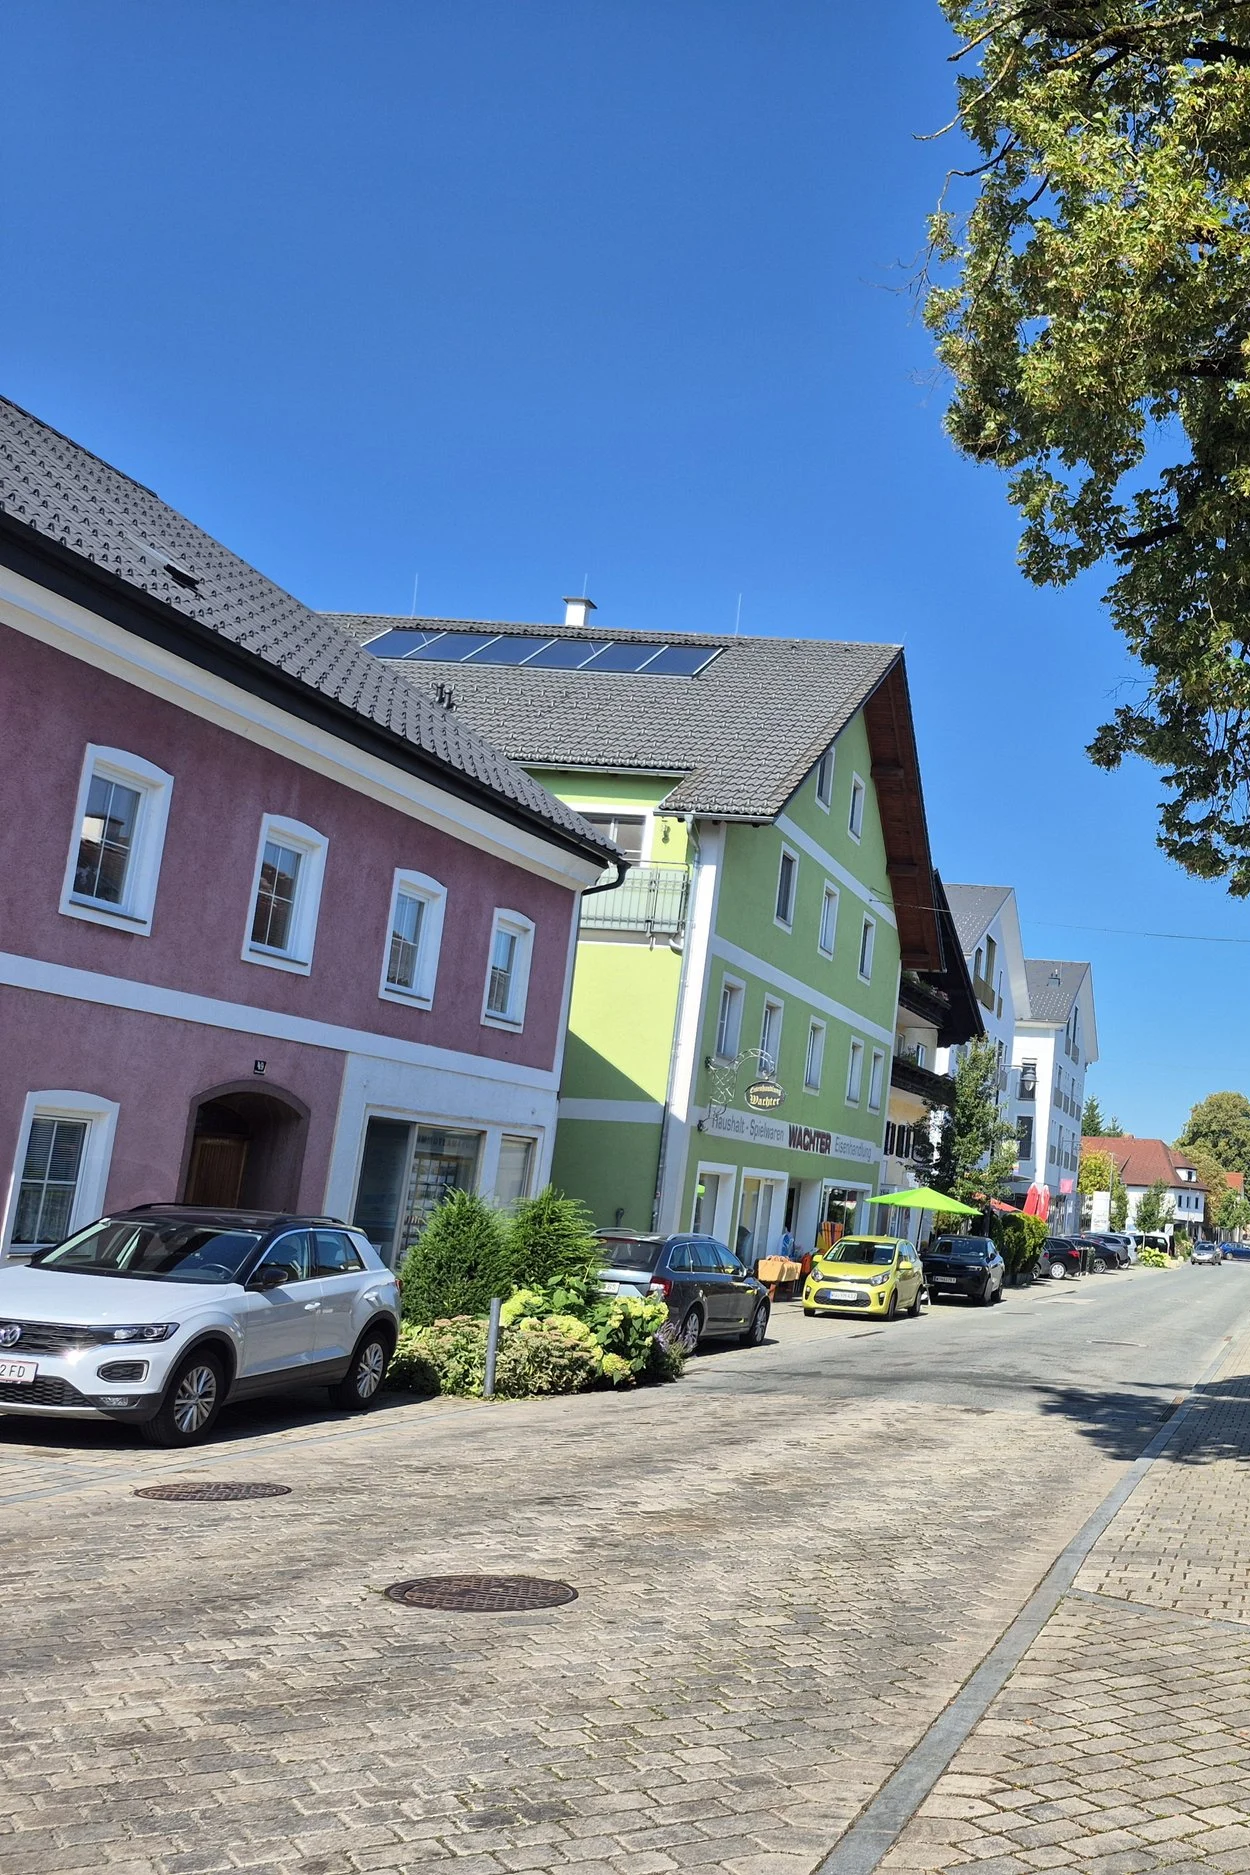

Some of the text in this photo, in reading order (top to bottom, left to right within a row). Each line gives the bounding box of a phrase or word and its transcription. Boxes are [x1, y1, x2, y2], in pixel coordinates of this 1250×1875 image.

[750, 1094, 781, 1107] Wachter
[712, 1112, 745, 1133] Haushalt
[749, 1119, 785, 1141] Spielwaren
[788, 1123, 832, 1155] WACHTER
[834, 1136, 872, 1162] Eisenhandlung
